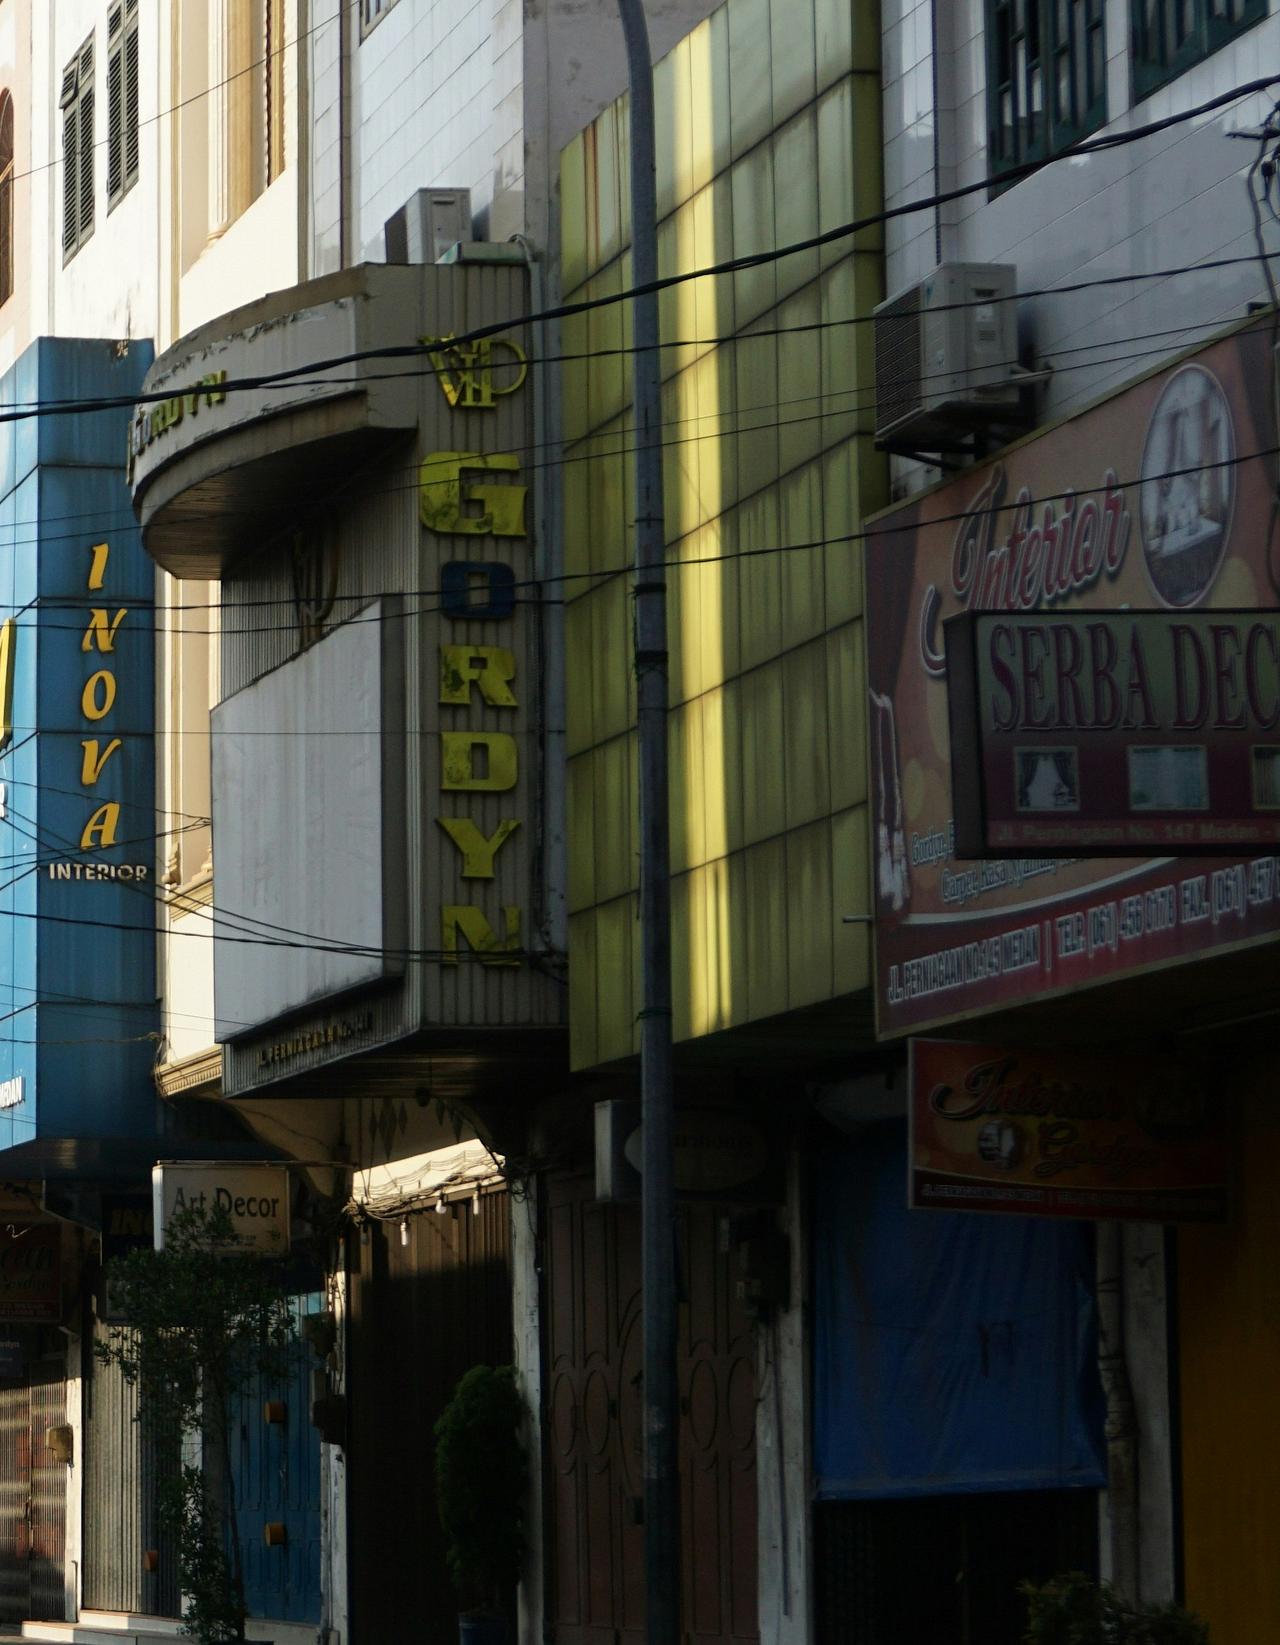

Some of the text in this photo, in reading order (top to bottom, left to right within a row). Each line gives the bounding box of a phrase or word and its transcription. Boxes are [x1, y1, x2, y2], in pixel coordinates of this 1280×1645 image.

[81, 543, 128, 850] INOVA
[419, 451, 528, 968] GORDYN
[989, 623, 1160, 731] SERBA
[49, 863, 147, 880] INTERIOR
[215, 1187, 279, 1218] Decor
